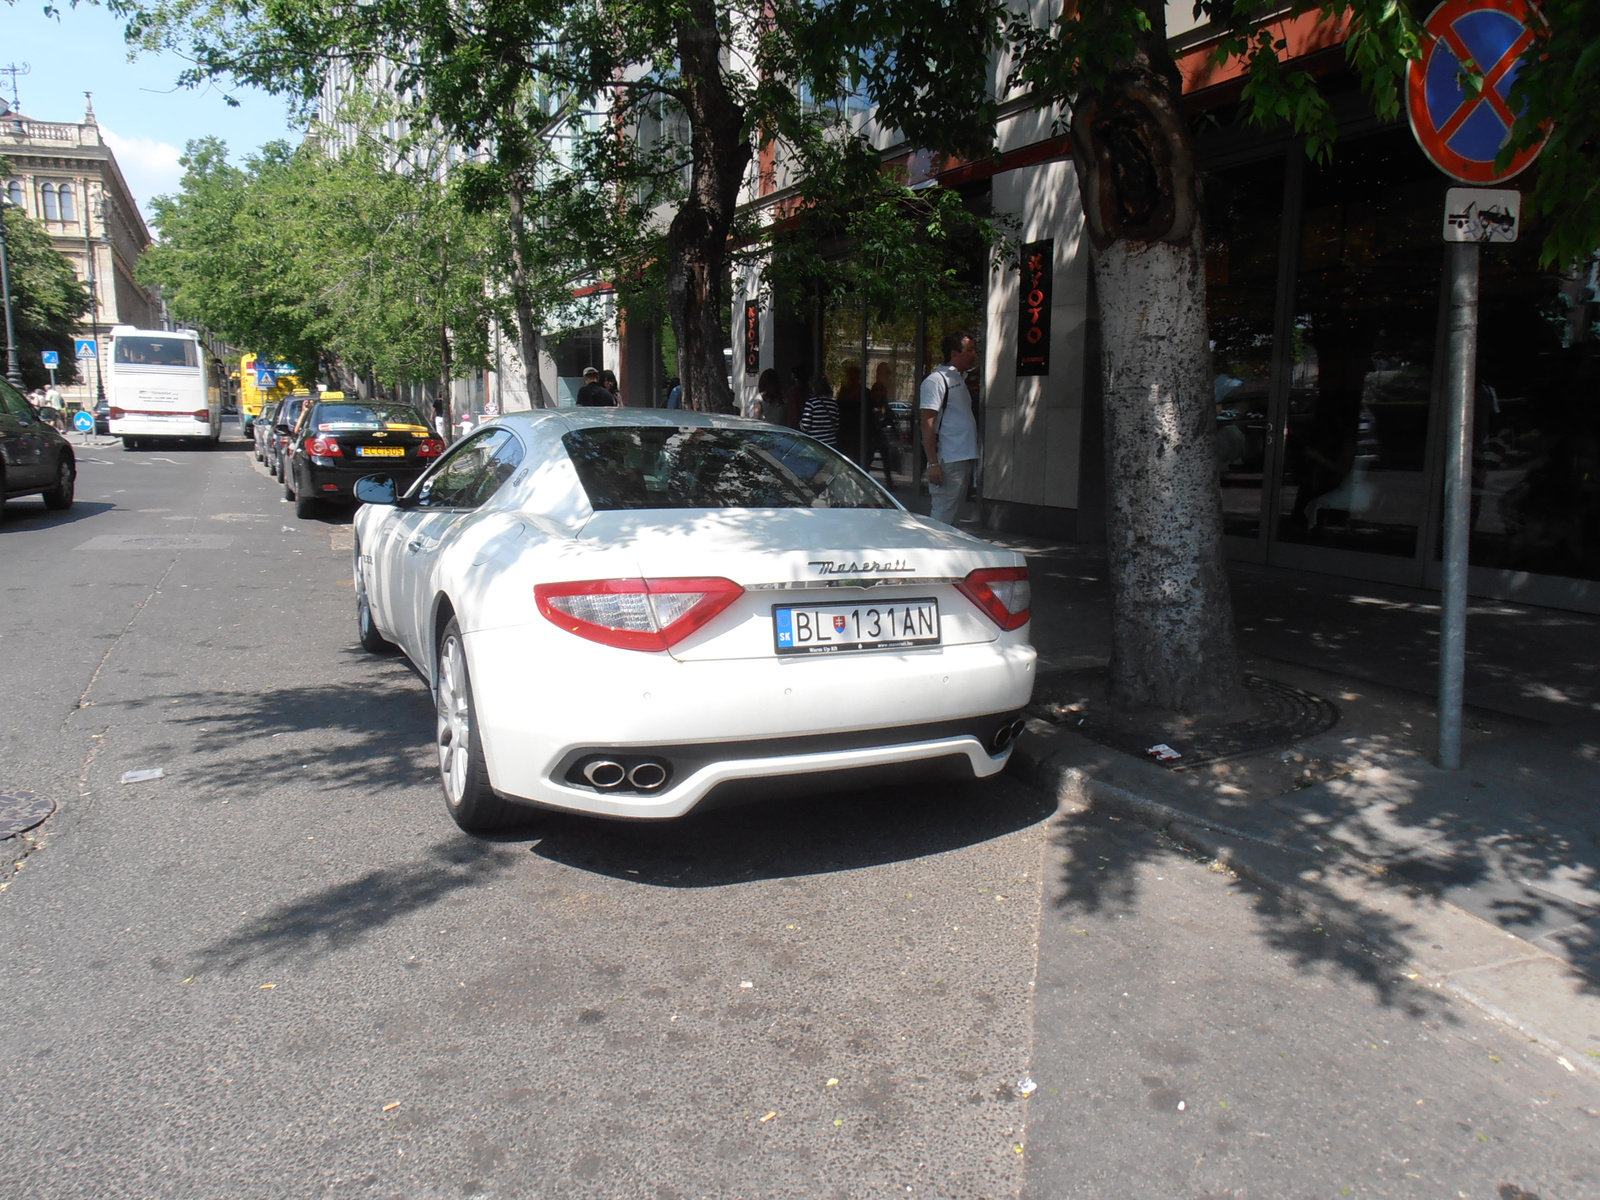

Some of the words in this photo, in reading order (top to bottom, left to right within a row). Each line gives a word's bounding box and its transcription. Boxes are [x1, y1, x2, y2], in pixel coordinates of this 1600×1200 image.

[1027, 253, 1044, 344] KYOTO
[748, 306, 756, 366] KYOTO
[807, 560, 915, 575] Maserati
[779, 632, 791, 641] SK
[795, 611, 832, 643] BL
[851, 606, 933, 639] 131AN
